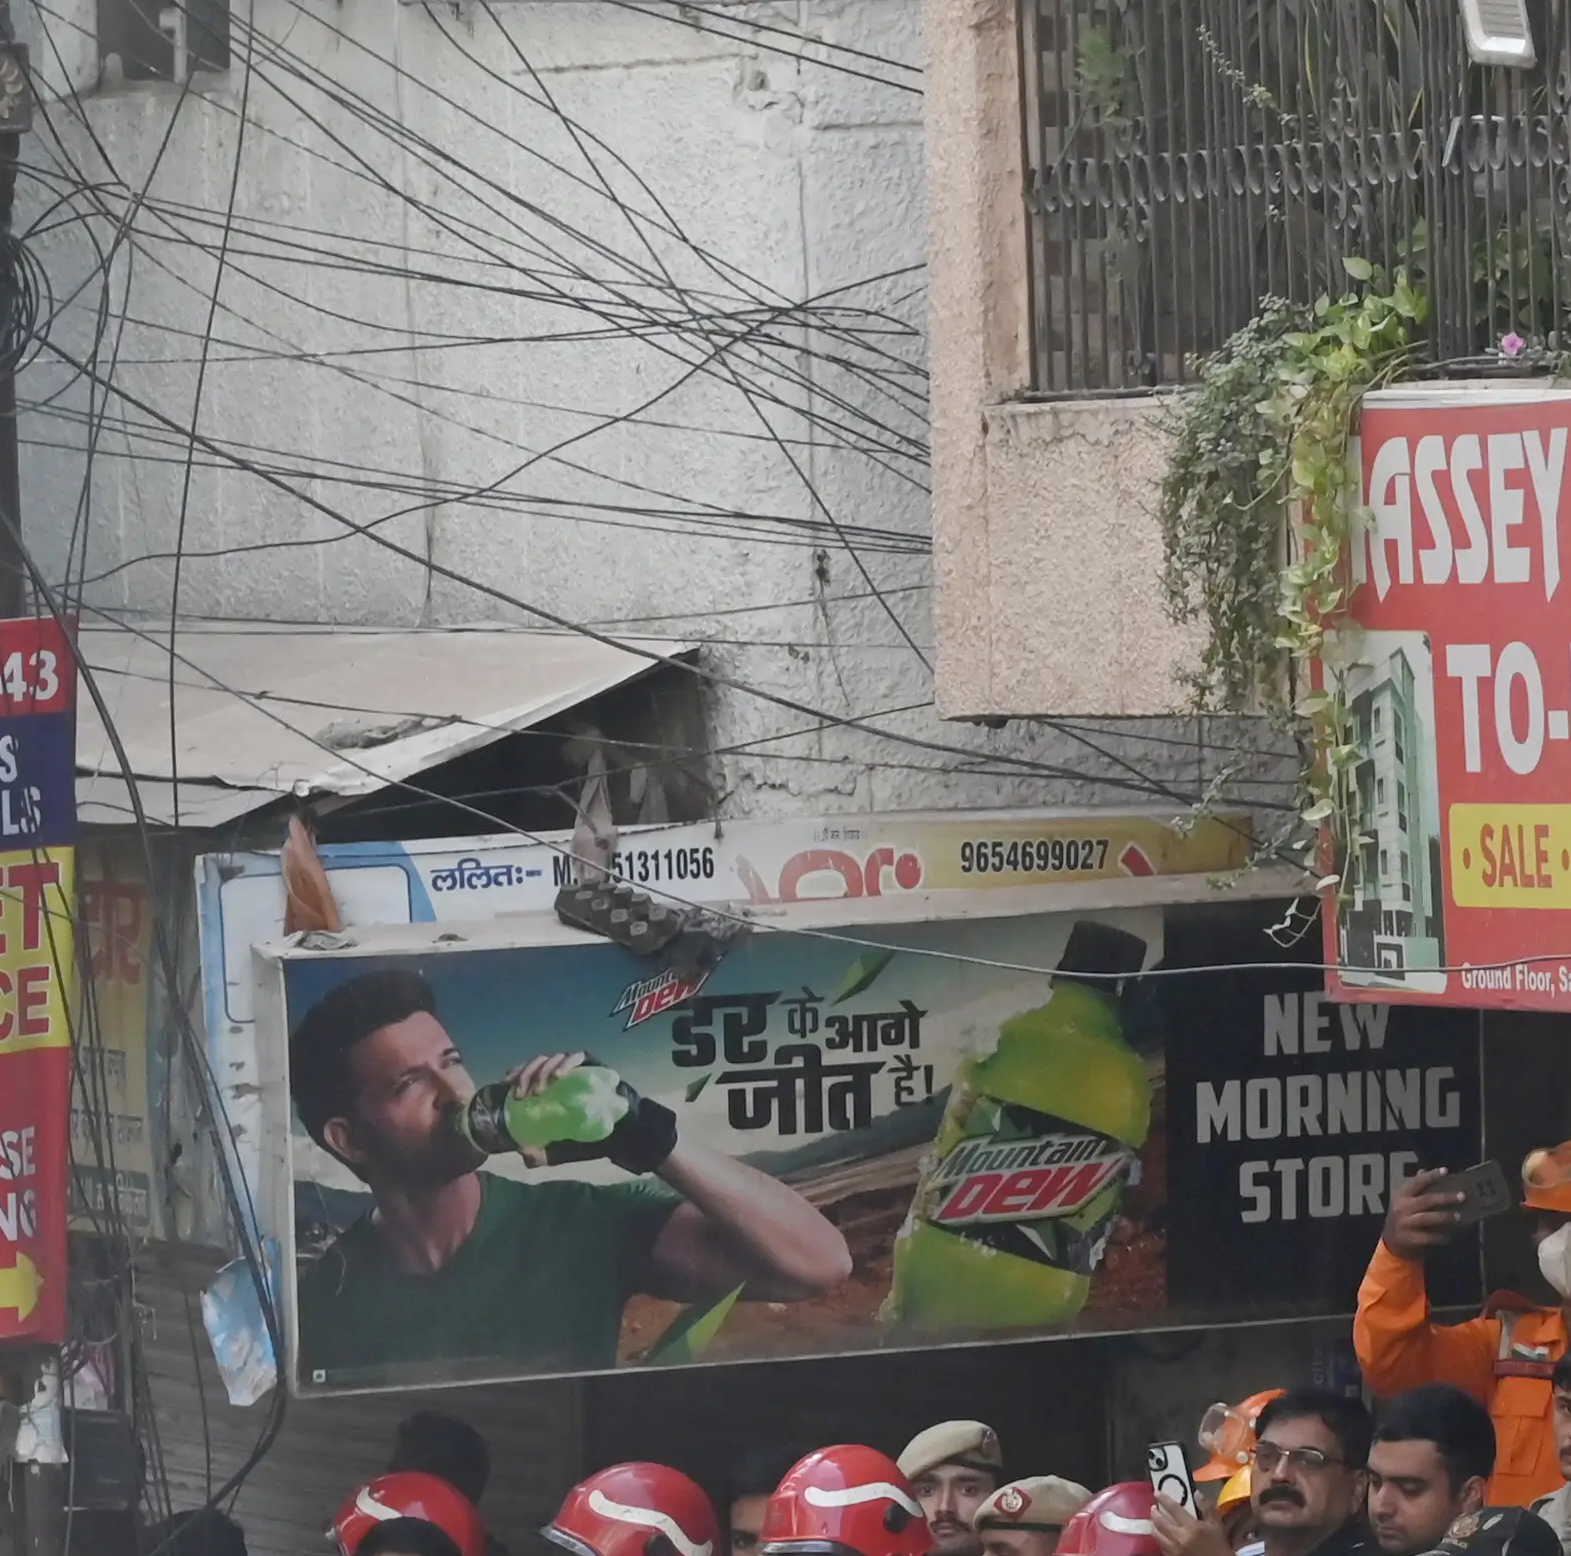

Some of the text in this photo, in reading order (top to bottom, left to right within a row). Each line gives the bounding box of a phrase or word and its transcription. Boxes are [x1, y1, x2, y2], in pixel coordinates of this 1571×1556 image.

[606, 847, 714, 883] 51311056
[960, 839, 1109, 873] 9654699027
[1480, 824, 1552, 889] SALE
[1462, 963, 1511, 990] Ground
[1515, 964, 1555, 997] Floor,
[666, 986, 929, 1067] डर के आगे
[1263, 991, 1390, 1056] NEW
[716, 1043, 886, 1135] जीत
[1196, 1067, 1460, 1143] MORNING
[943, 1139, 1099, 1178] Mountain
